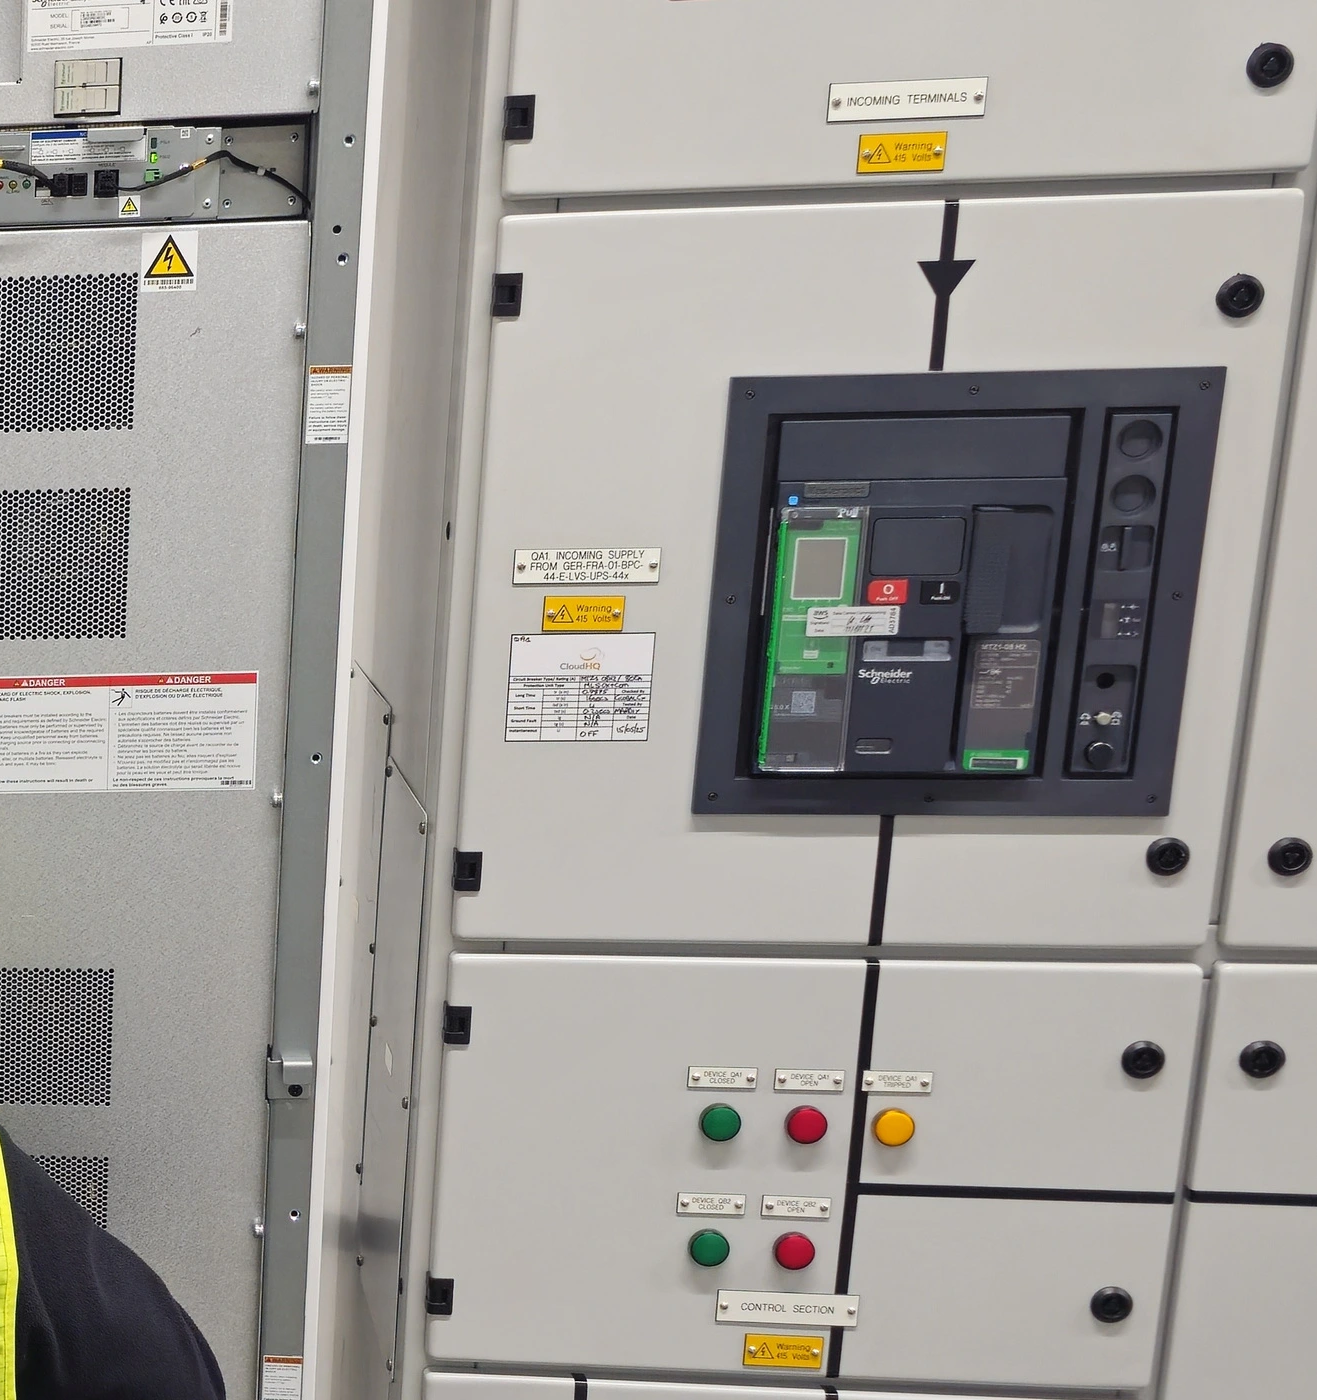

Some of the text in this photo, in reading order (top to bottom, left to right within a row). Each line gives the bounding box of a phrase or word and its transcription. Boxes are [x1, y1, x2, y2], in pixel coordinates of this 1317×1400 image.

[846, 91, 968, 107] INCOMING TERMINALS
[894, 141, 933, 151] Warning
[893, 152, 932, 162] 415 Volts
[837, 507, 859, 518] Pull
[555, 550, 603, 560] INCOMING
[608, 549, 645, 559] SUPPLY
[529, 560, 644, 571] FROM GER-FRA-01-BPC-
[543, 571, 630, 581] 44-E-LVS-UPS-44x
[576, 604, 613, 614] Warning
[575, 614, 612, 623] 415 Volts
[560, 662, 601, 671] CloudHQ
[858, 668, 913, 680] Schneider
[28, 679, 66, 687] DANGER
[174, 676, 212, 684] DANGER
[878, 1074, 897, 1082] DEVICE
[740, 1302, 835, 1315] CONTROL SECTION
[776, 1342, 811, 1352] Warning
[792, 1353, 810, 1361] Volts
